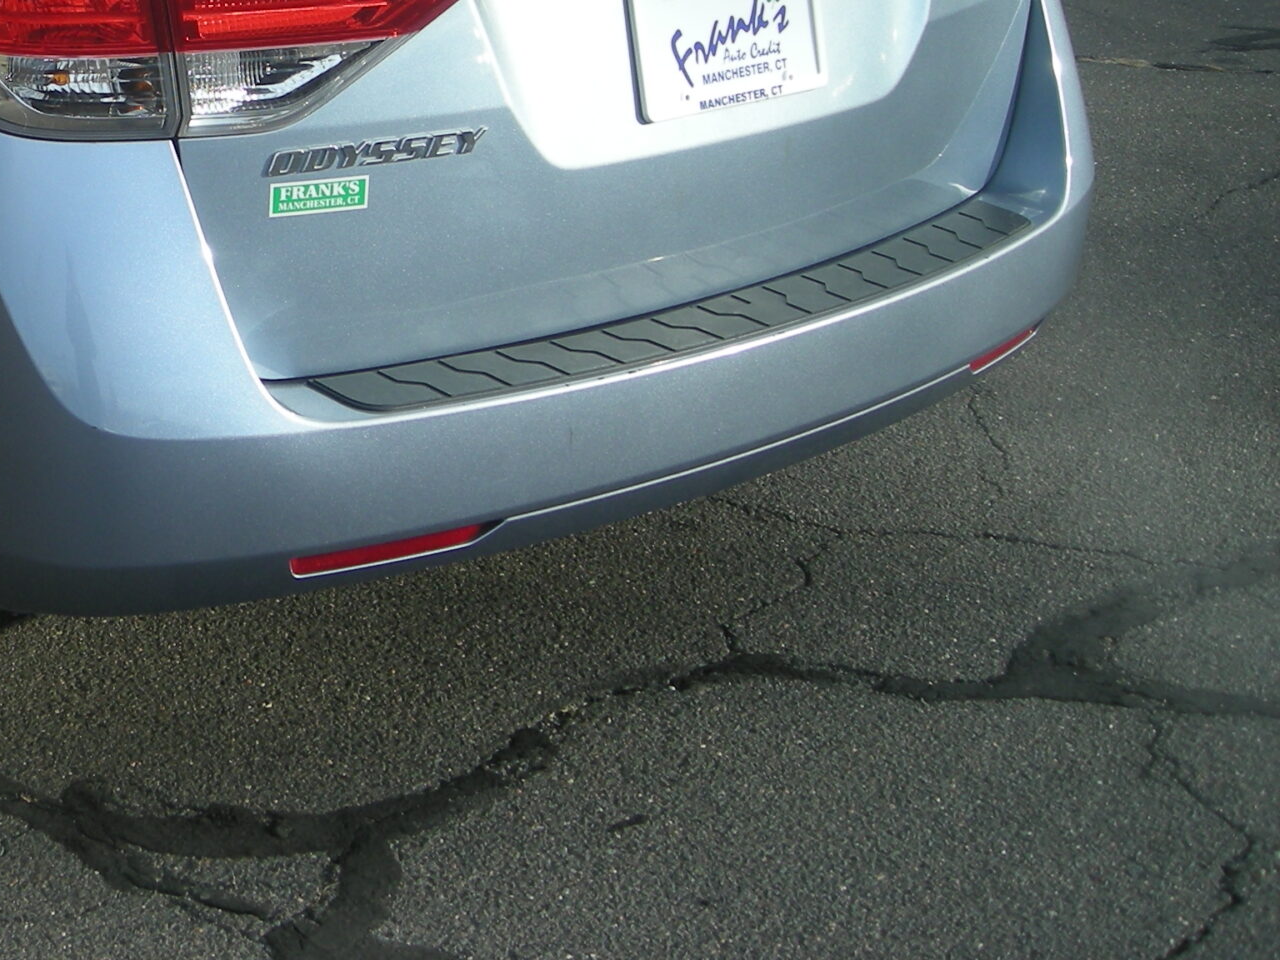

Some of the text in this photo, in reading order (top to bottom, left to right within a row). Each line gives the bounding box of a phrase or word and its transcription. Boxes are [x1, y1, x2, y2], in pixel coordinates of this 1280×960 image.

[723, 40, 782, 63] Auto Credit
[702, 57, 788, 85] MANCHESTER, CT
[699, 84, 784, 111] MANCHESTER, CT
[262, 125, 489, 178] ODYSSEY
[279, 180, 361, 201] FRANK'S
[278, 195, 361, 212] MANCHESTER, CT
